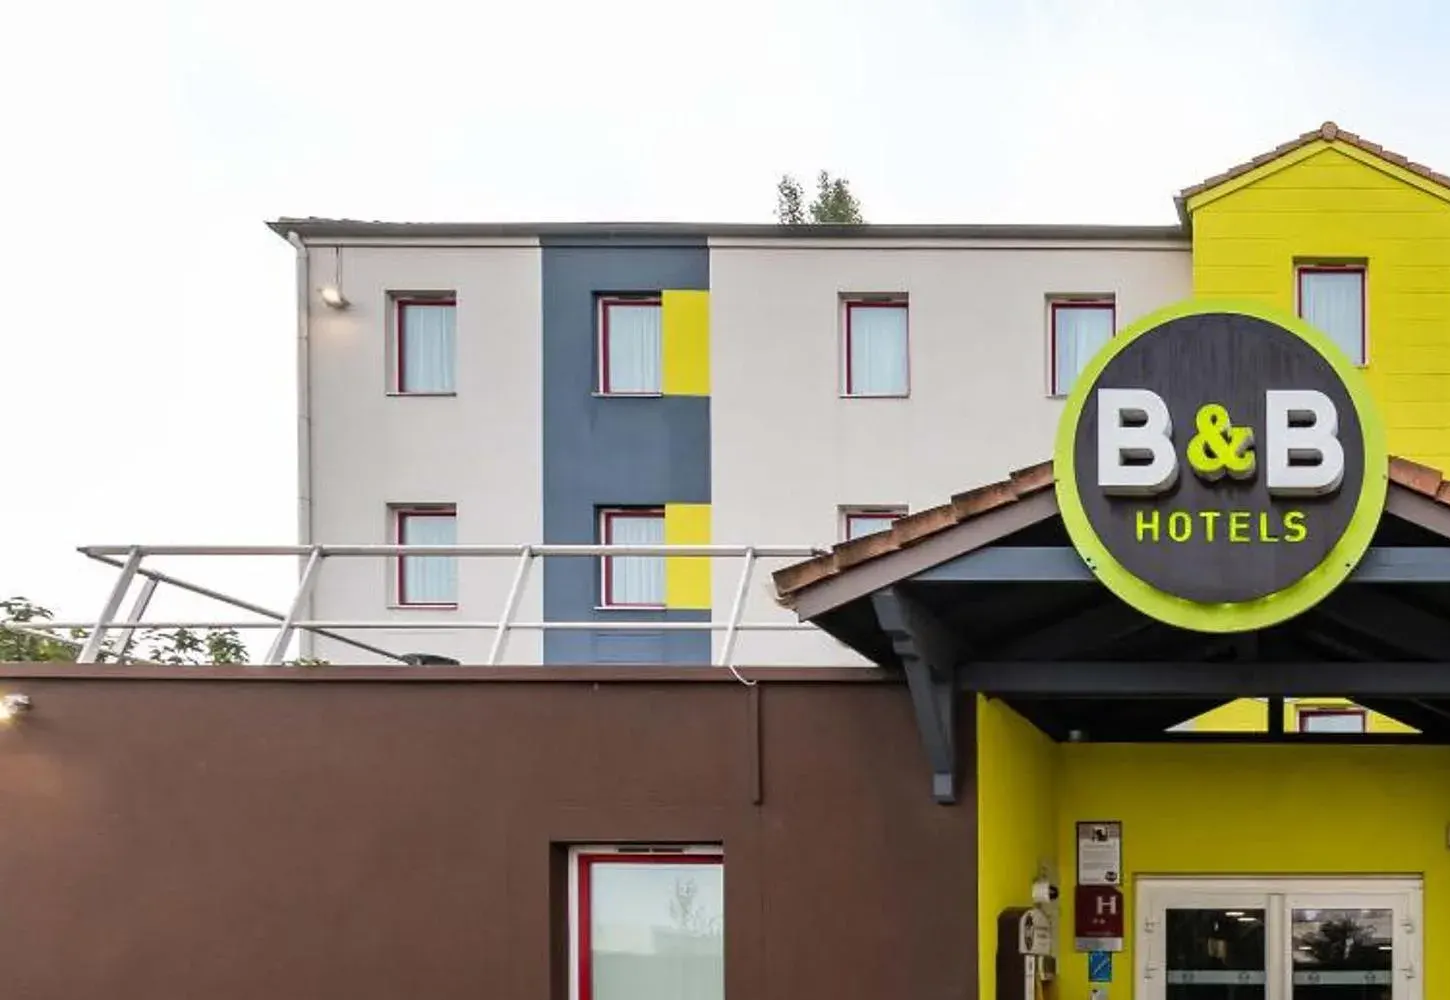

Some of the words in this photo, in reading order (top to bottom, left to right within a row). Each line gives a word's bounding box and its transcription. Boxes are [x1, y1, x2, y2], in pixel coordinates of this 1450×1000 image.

[1097, 388, 1345, 496] B&B
[1135, 510, 1309, 543] HOTELS
[1096, 895, 1117, 915] H
